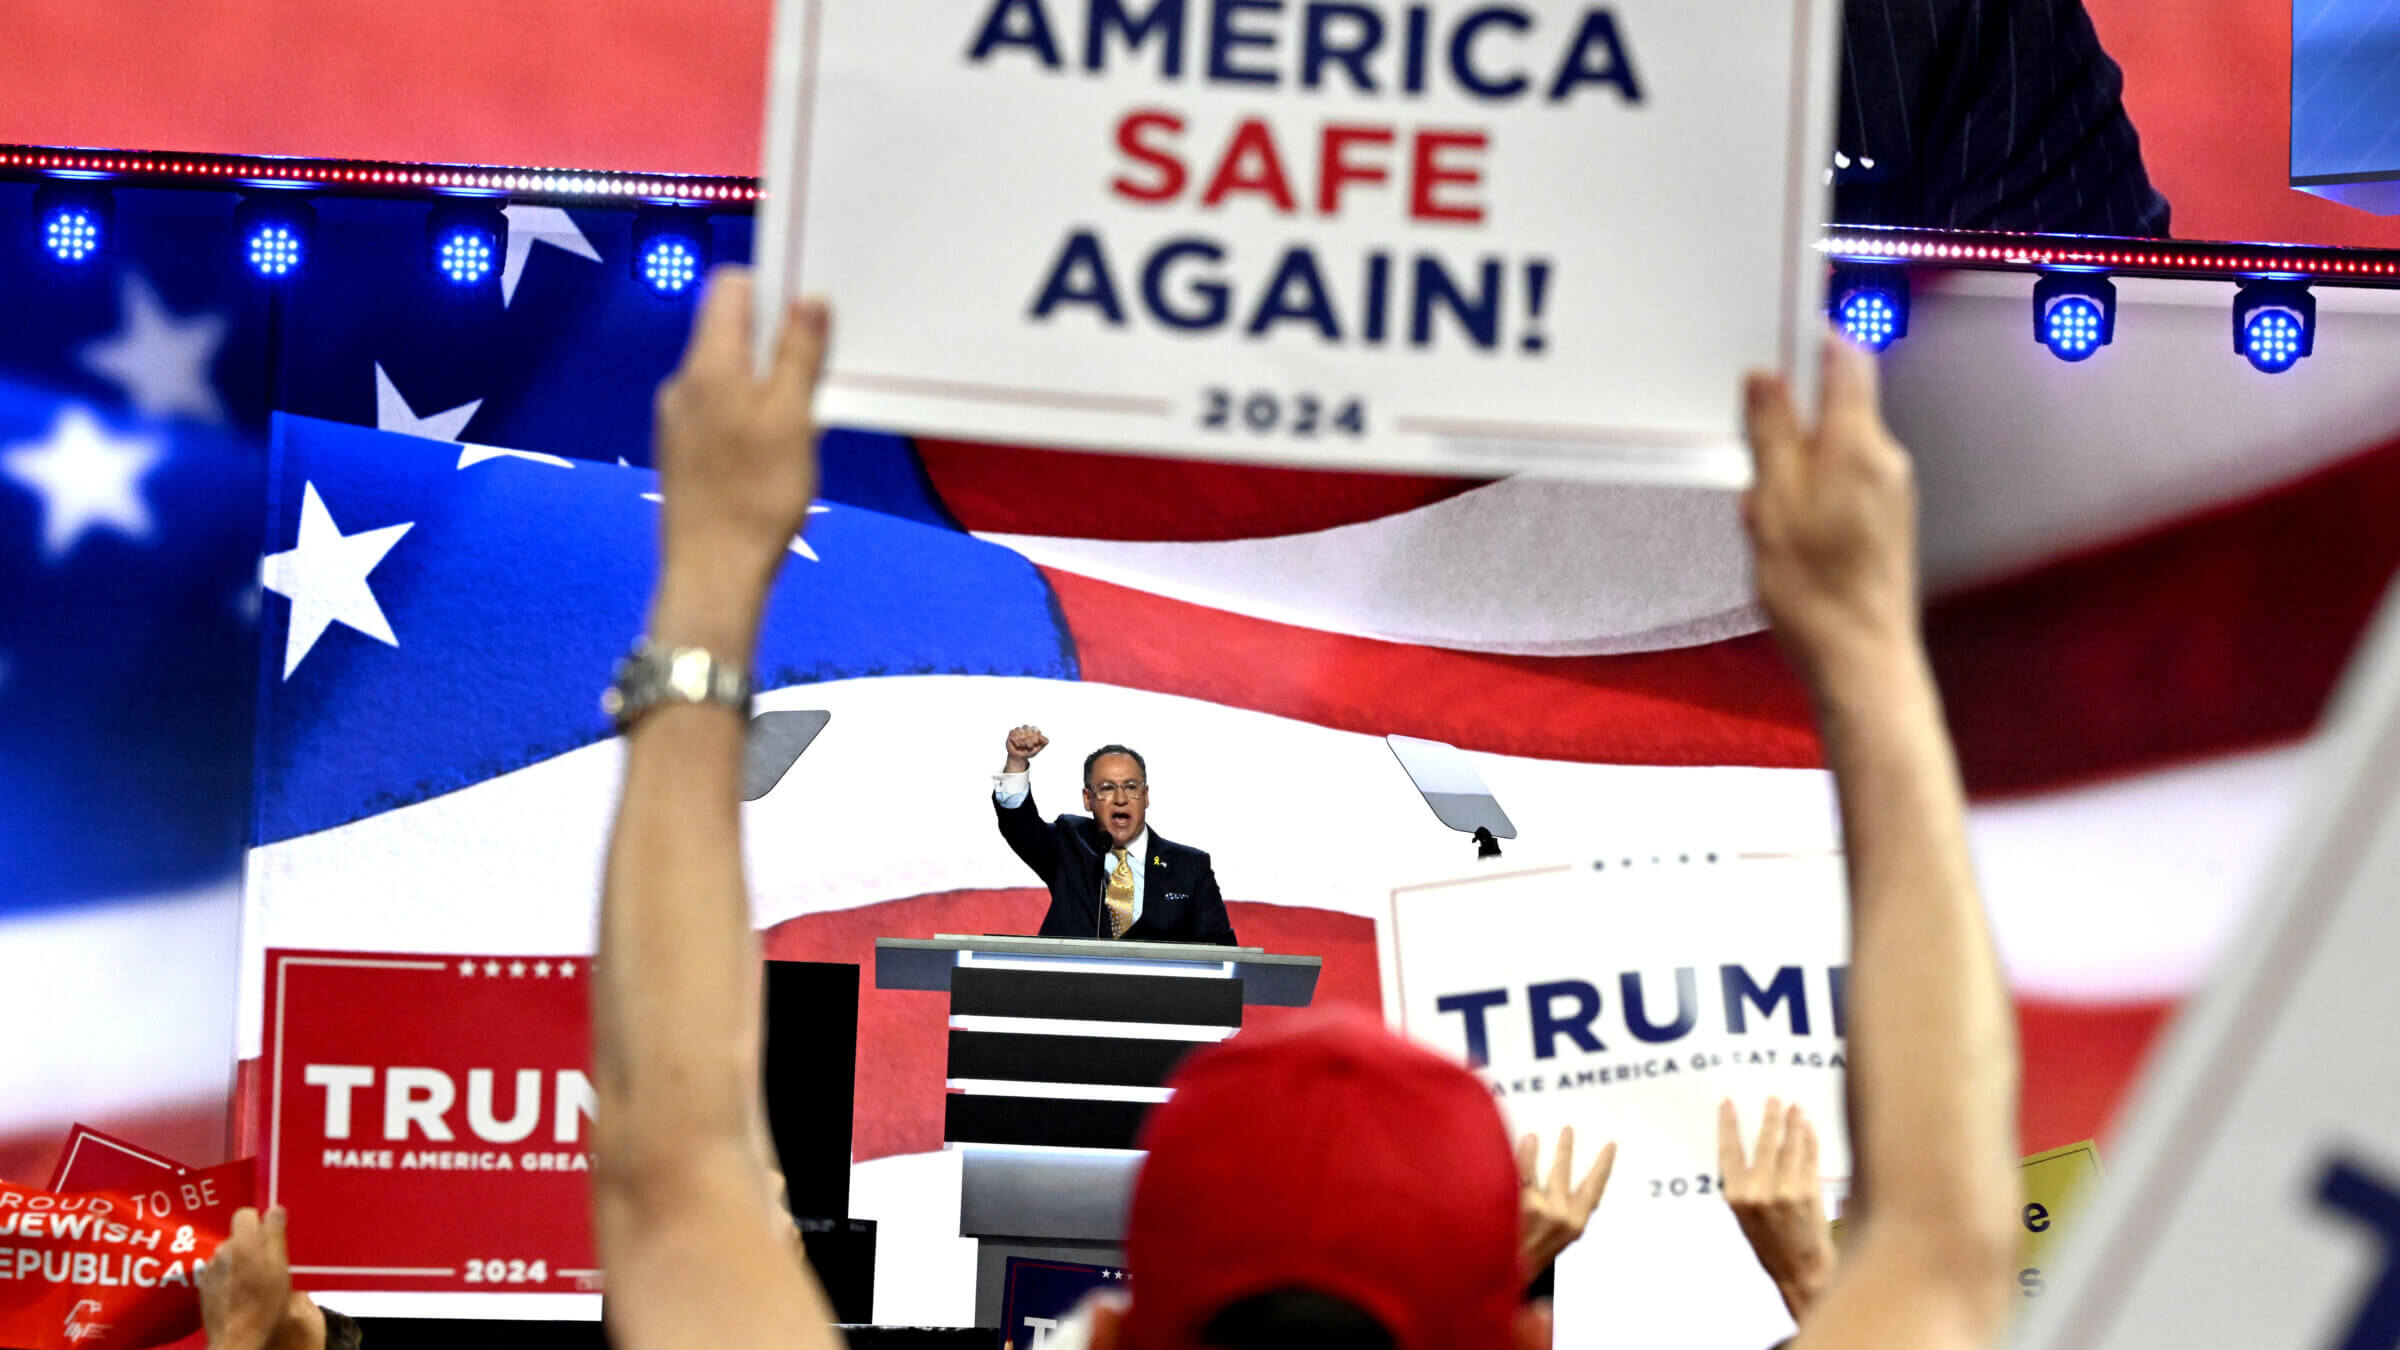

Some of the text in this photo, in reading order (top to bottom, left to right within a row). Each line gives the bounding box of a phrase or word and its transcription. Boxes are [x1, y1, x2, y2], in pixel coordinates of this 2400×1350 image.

[966, 0, 1646, 105] AMERICA
[1110, 108, 1490, 225] SAFE
[1027, 227, 1554, 354] AGAIN!
[1198, 388, 1366, 438] 2024
[1558, 1058, 1679, 1090] AMERICA
[322, 1150, 393, 1168] MAKE
[400, 1151, 513, 1171] AMERICA
[130, 1190, 172, 1220] TO
[180, 1179, 219, 1210] BE
[1648, 1173, 1725, 1198] 202
[0, 1212, 196, 1253] JEWISH &
[464, 1260, 548, 1283] 2024
